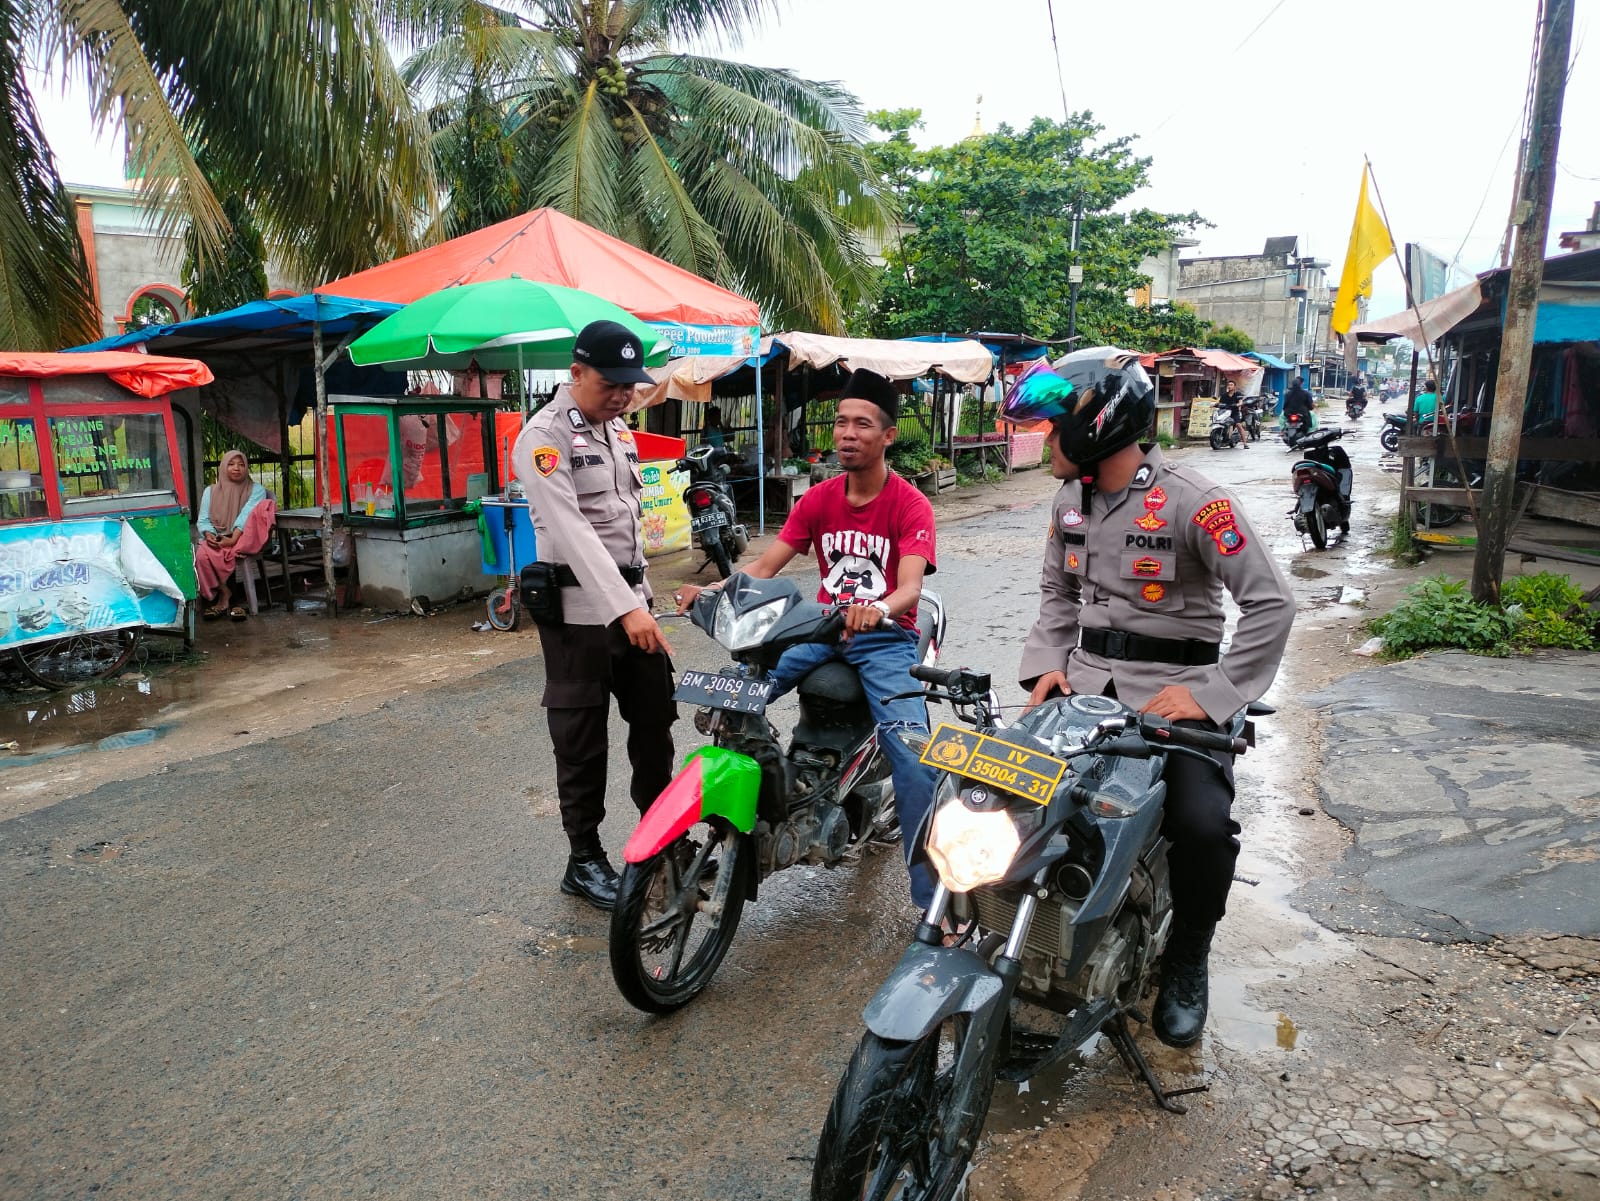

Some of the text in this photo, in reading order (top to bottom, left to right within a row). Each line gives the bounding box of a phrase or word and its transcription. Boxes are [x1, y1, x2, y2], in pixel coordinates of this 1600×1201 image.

[1208, 514, 1231, 530] RIAU
[1125, 534, 1173, 550] POLRI
[681, 672, 770, 698] BM 3069 GM
[723, 699, 739, 709] 02
[1007, 750, 1031, 764] IV
[971, 760, 1018, 785] 35004
[1028, 779, 1050, 797] 31
